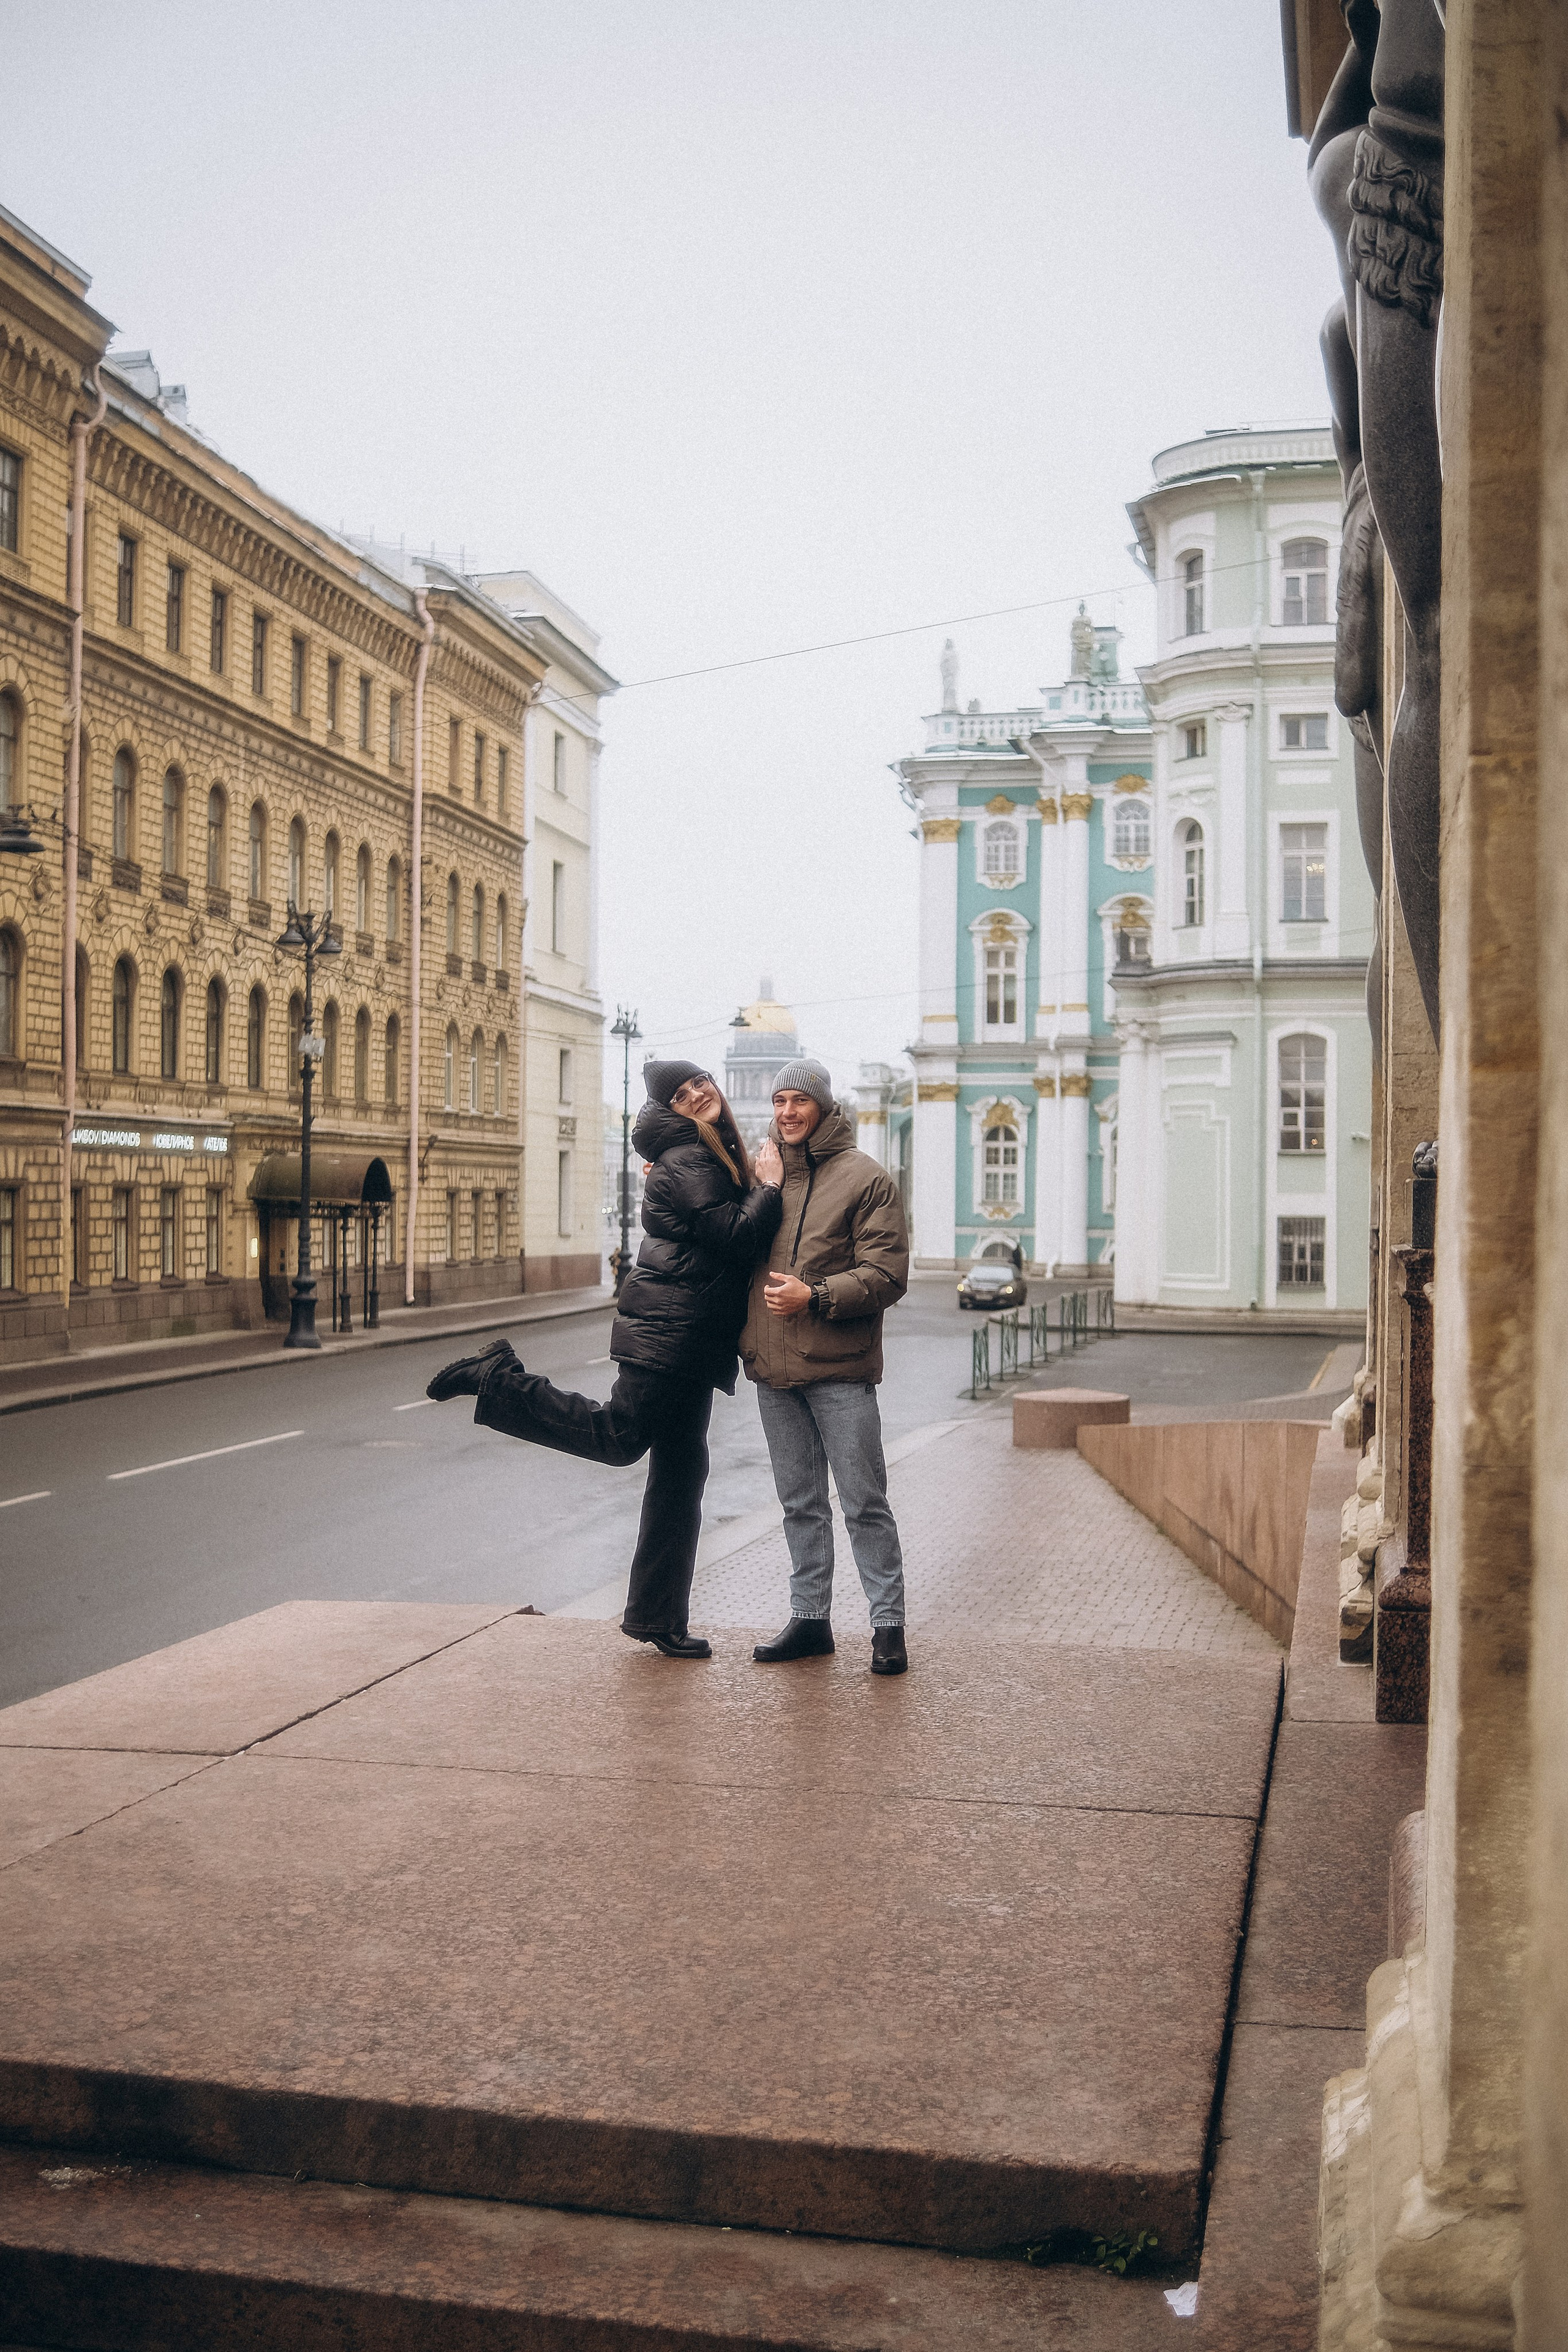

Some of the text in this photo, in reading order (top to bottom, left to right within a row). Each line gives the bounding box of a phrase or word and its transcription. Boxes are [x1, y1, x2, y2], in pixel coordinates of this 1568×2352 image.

[101, 1130, 141, 1147] DIAMONDS
[156, 1133, 228, 1152] ЮВЕЛИРНОЕ АТЕЛЬЕ
